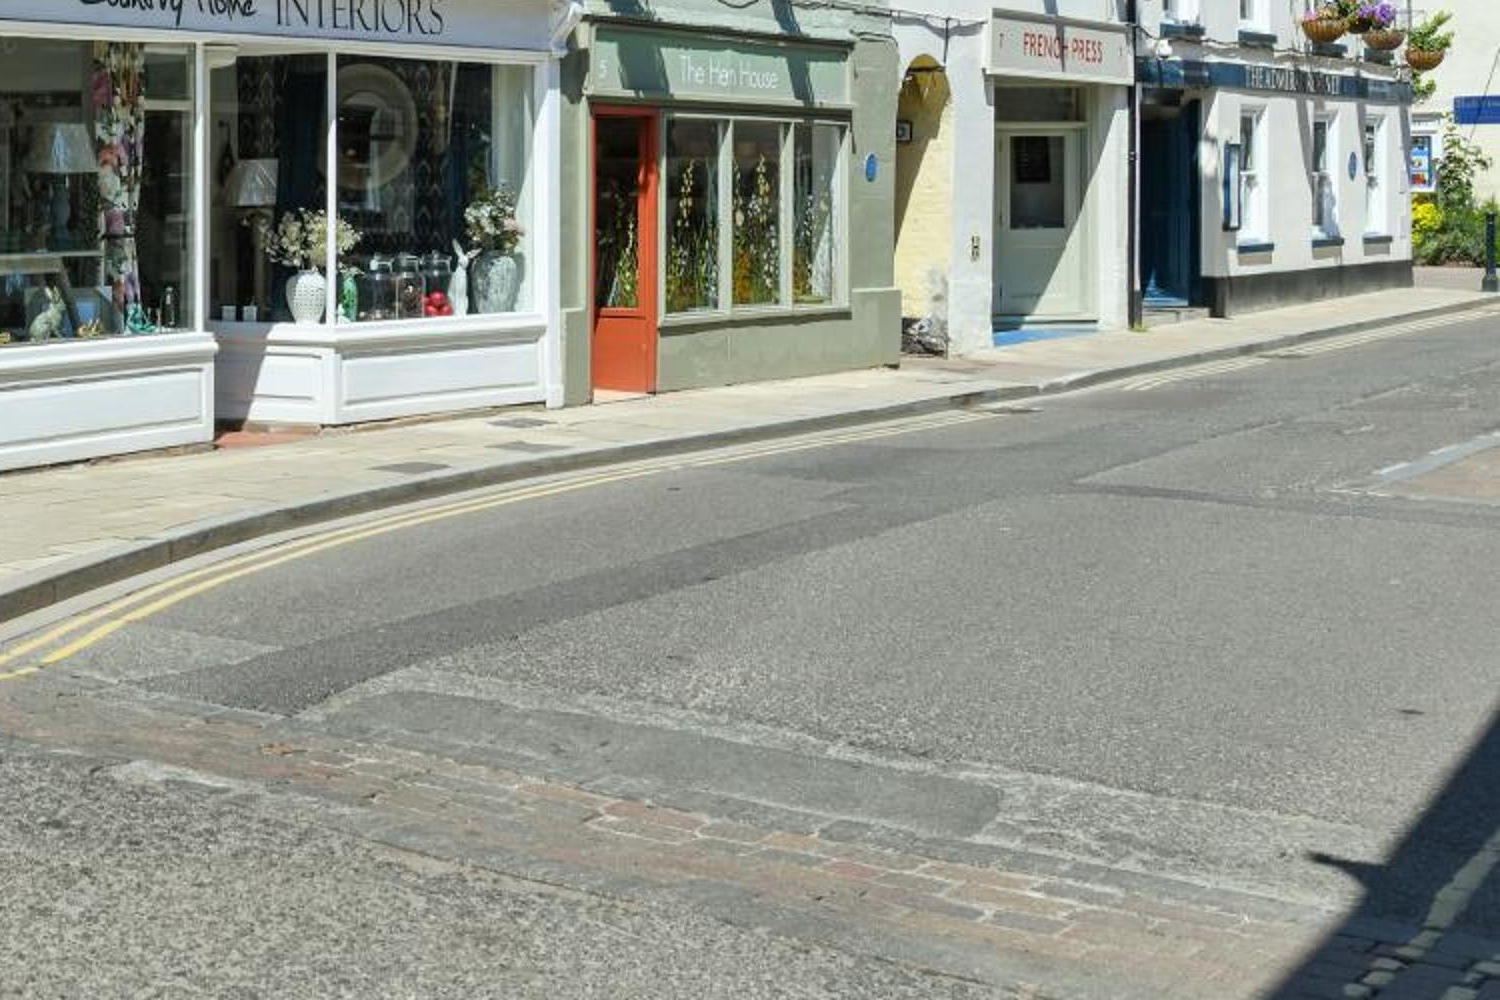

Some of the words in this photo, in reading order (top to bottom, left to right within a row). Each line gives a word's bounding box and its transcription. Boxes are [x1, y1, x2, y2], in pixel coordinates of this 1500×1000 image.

[1072, 37, 1103, 63] PRESS
[680, 53, 705, 85] The
[739, 58, 779, 90] House
